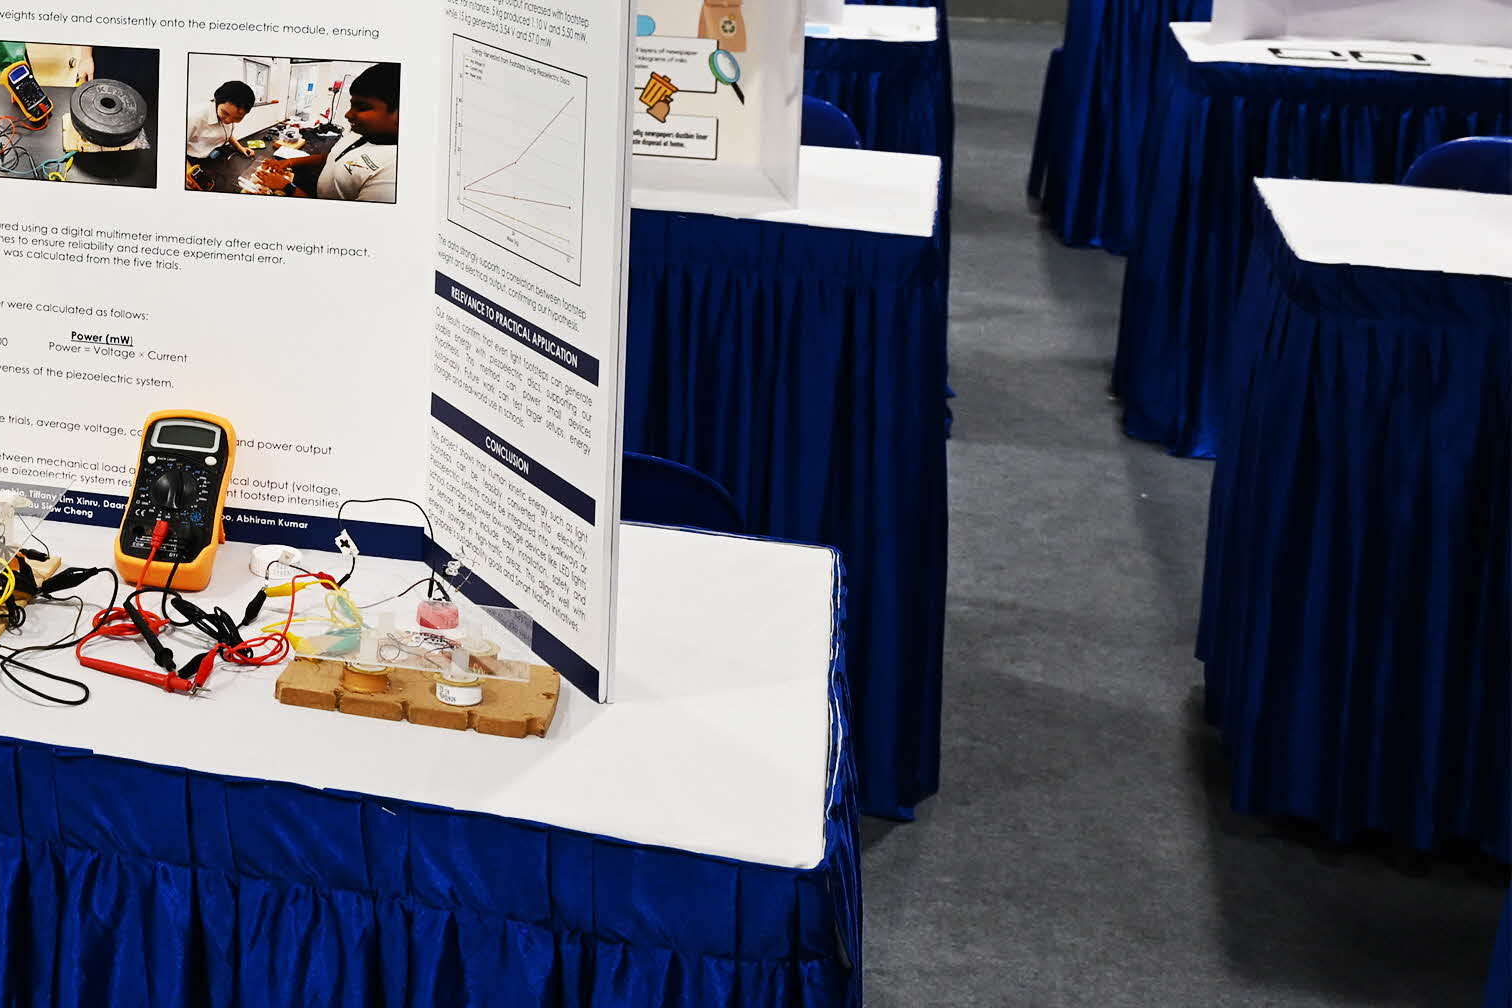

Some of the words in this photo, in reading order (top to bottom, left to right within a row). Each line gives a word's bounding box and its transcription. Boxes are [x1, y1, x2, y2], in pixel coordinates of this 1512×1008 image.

[451, 286, 485, 315] RELEVANCE
[486, 306, 495, 320] TO
[496, 310, 531, 341] PRACTICAL
[532, 333, 578, 368] APPLICATION
[71, 331, 102, 344] Power
[105, 333, 133, 346] (mW)
[485, 436, 529, 475] CONCLUSION
[59, 495, 74, 504] Lim
[76, 497, 100, 508] Xinru,
[64, 507, 94, 518] Cheng
[236, 514, 276, 525] Abhiram
[277, 518, 308, 529] Kumar
